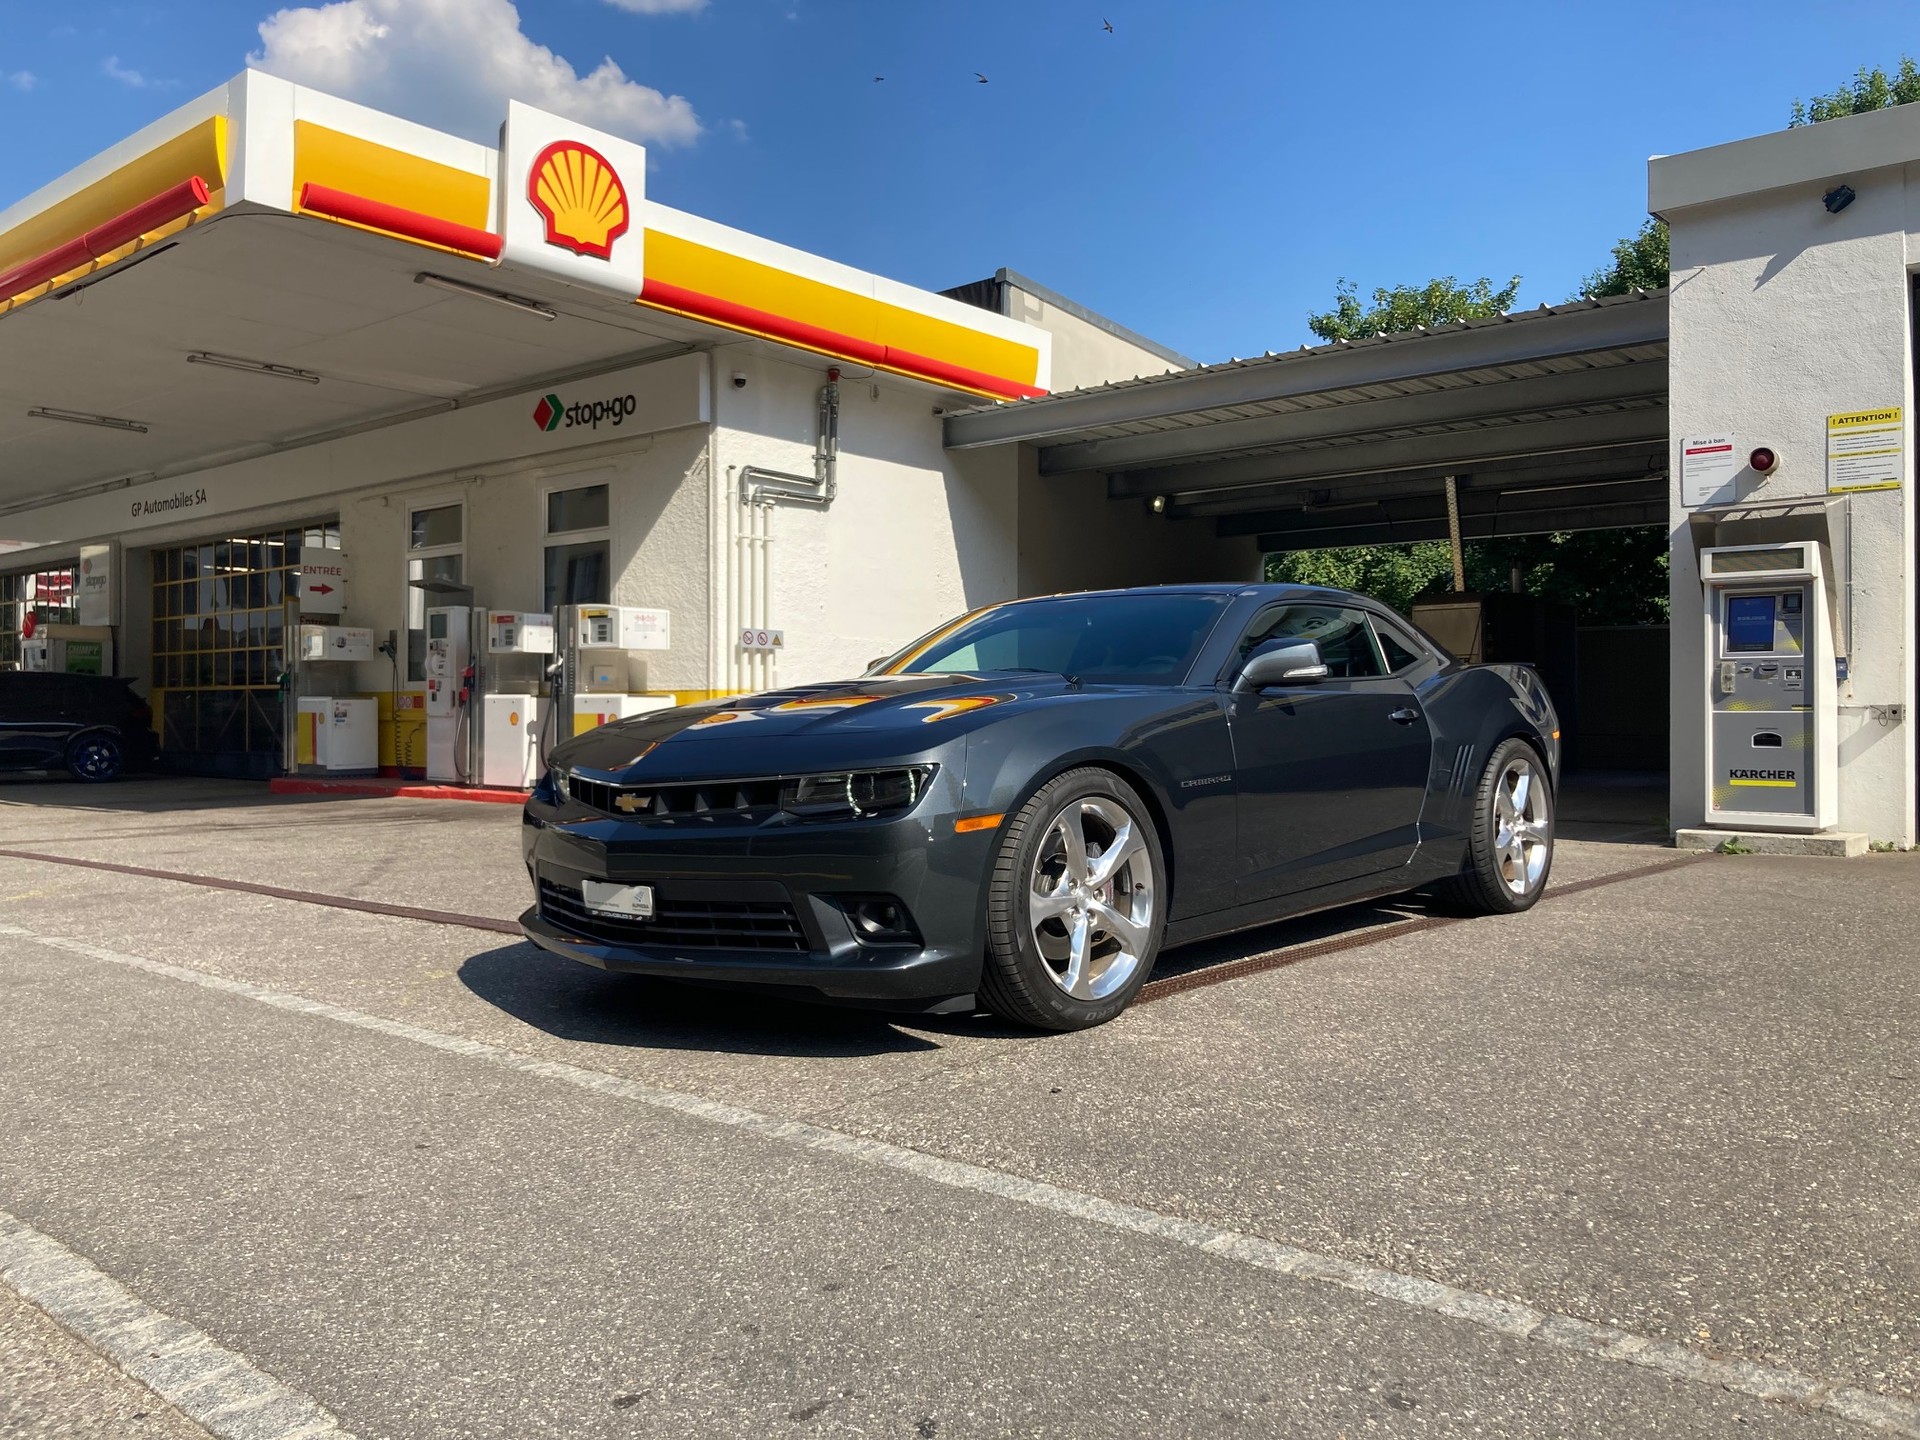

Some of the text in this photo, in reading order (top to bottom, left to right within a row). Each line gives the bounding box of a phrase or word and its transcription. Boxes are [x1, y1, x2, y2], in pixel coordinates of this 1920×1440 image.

[565, 395, 636, 430] stop+go
[1838, 413, 1892, 424] ATTENTION
[131, 488, 207, 517] GP Automobiles SA
[303, 565, 342, 576] ENTRÉE
[1729, 769, 1796, 780] KÄRCHER
[1181, 775, 1232, 788] CAMARO
